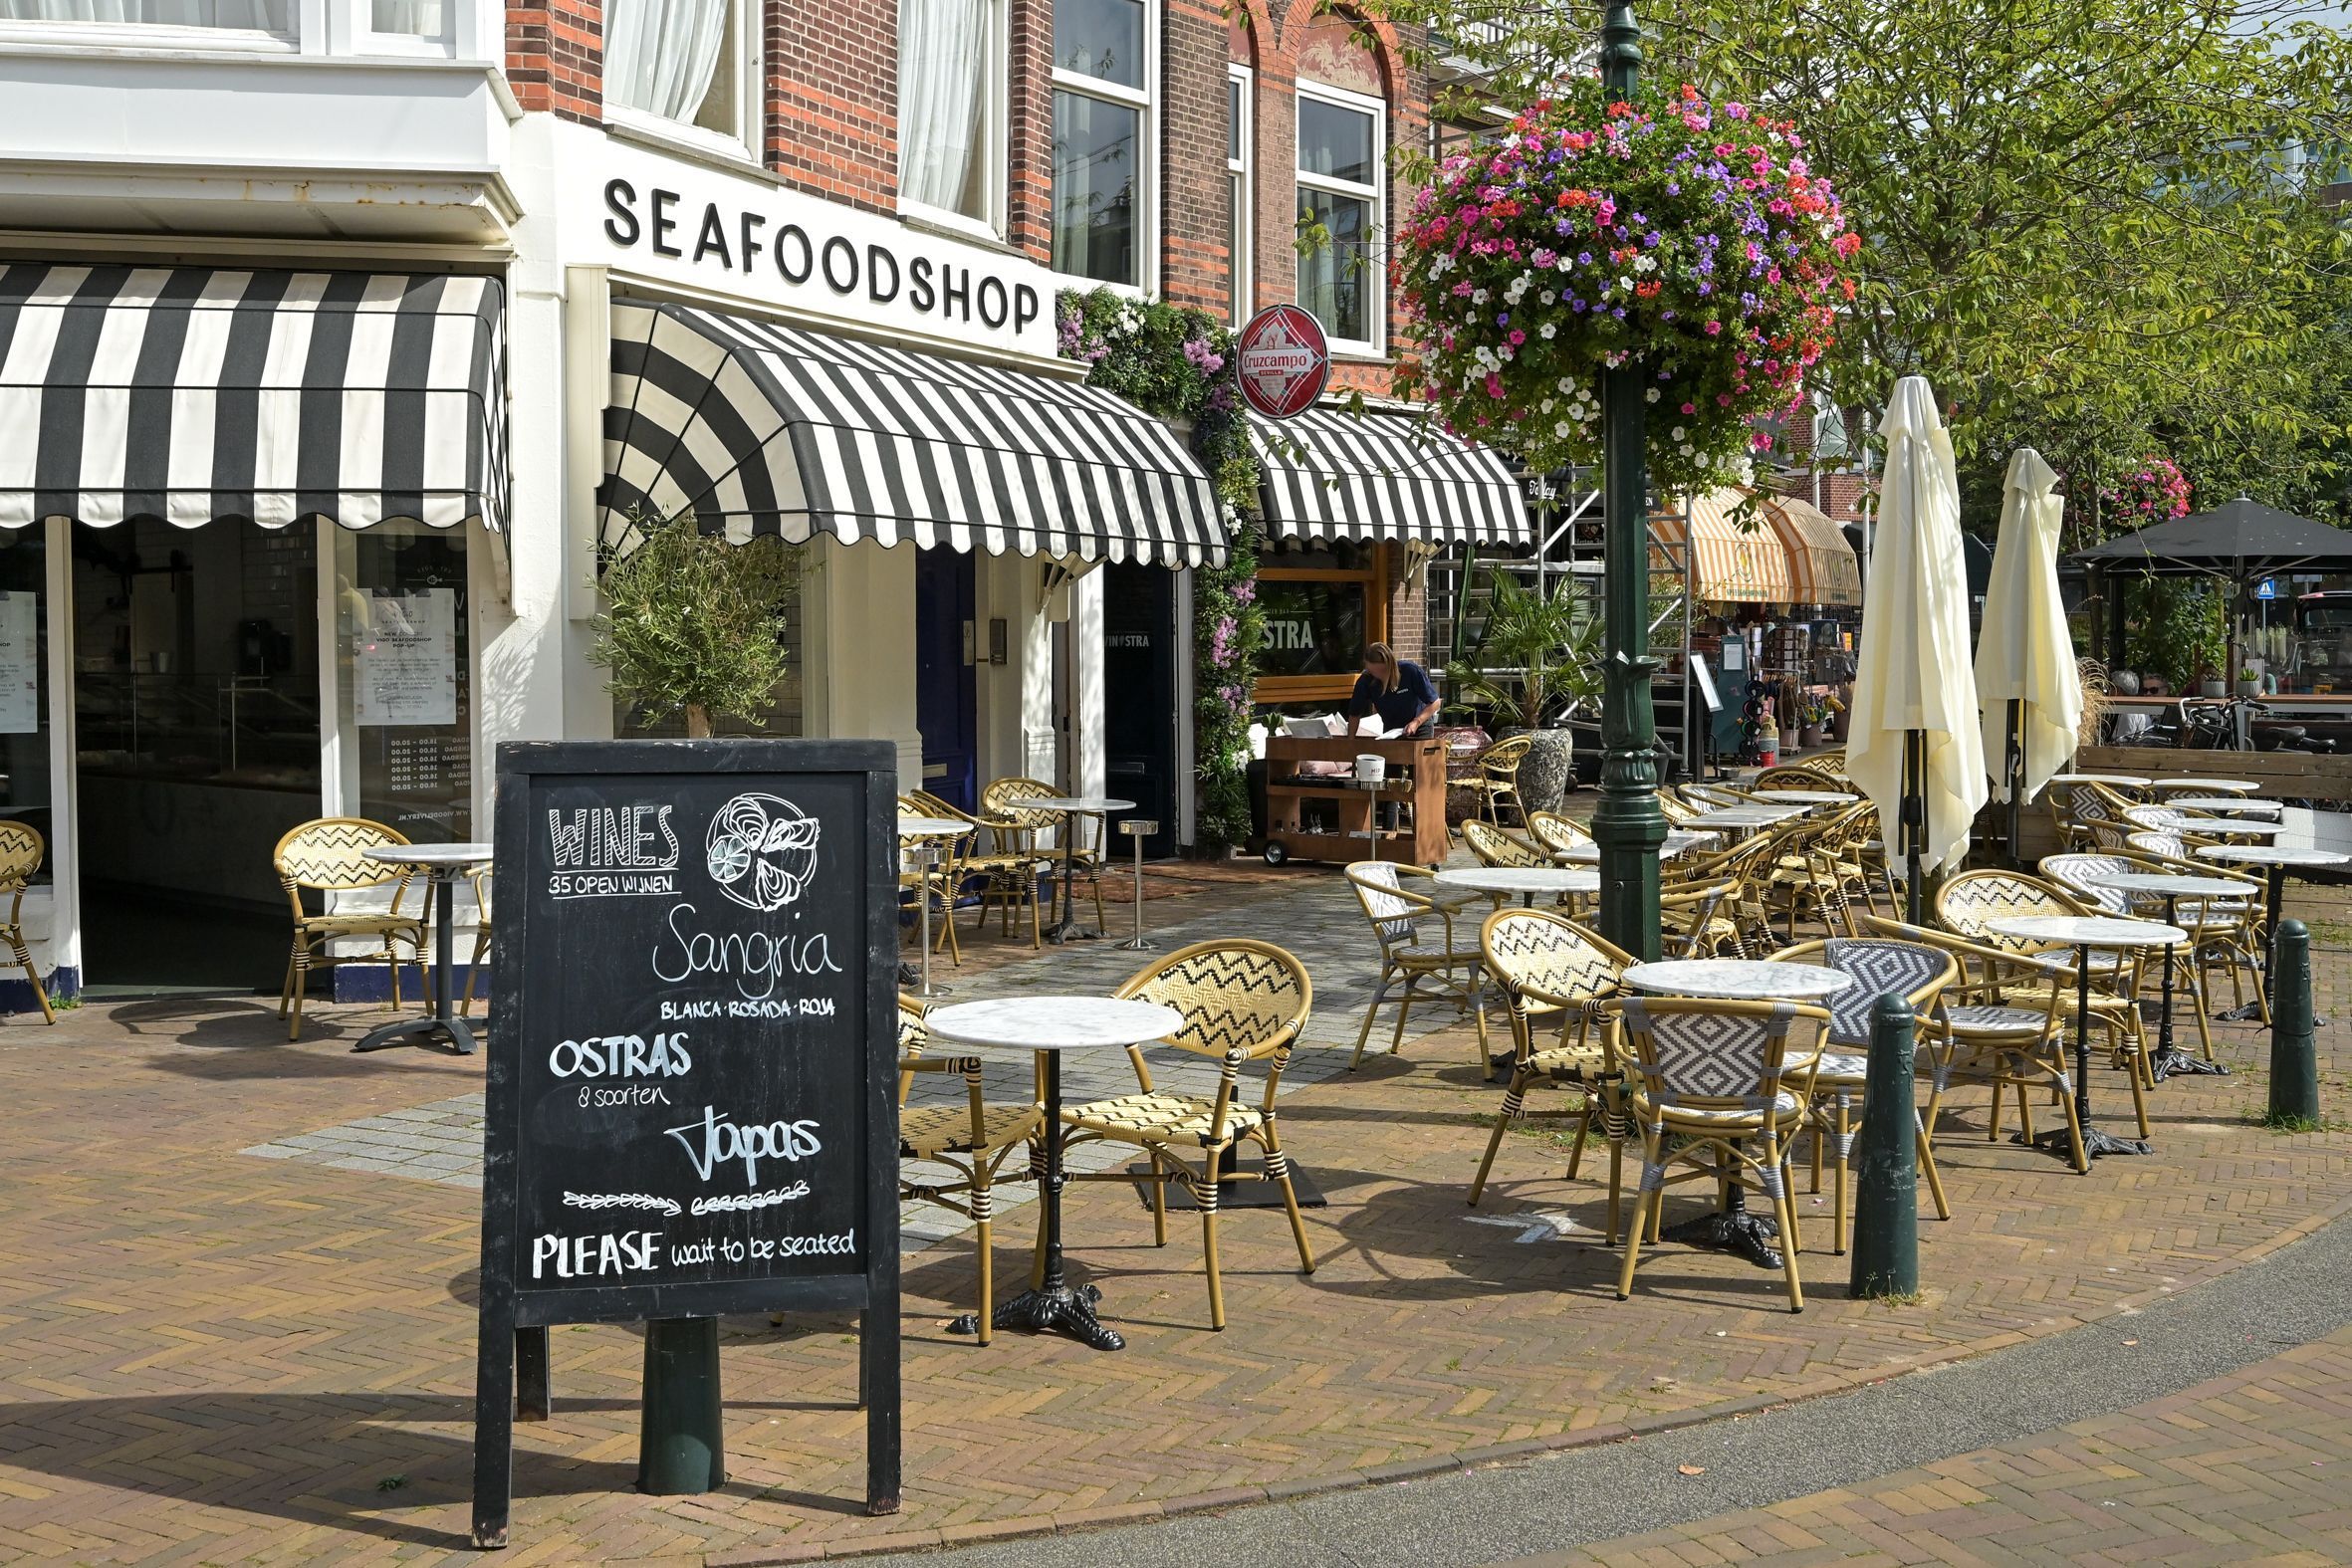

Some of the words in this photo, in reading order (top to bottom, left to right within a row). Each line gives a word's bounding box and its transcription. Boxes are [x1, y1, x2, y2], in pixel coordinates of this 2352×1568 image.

[603, 177, 1040, 335] SEAFOODSHOP
[1244, 353, 1307, 369] Cruzcampo
[548, 804, 679, 868] WINES
[549, 876, 572, 894] 35
[576, 875, 618, 894] OPEN
[621, 874, 673, 894] WIJNEN
[652, 902, 843, 1001] Sangria
[660, 1001, 722, 1020] BLANCA
[728, 1000, 792, 1018] ROSADA
[799, 998, 836, 1016] ROJA
[549, 1031, 692, 1078] OSTRAS
[578, 1085, 590, 1108] 8
[593, 1083, 671, 1106] soorten
[663, 1105, 823, 1187] Tapas
[532, 1230, 664, 1279] PLEASE
[671, 1236, 716, 1267] wait
[719, 1236, 746, 1263] to
[750, 1236, 775, 1259] be
[779, 1228, 857, 1258] seated
